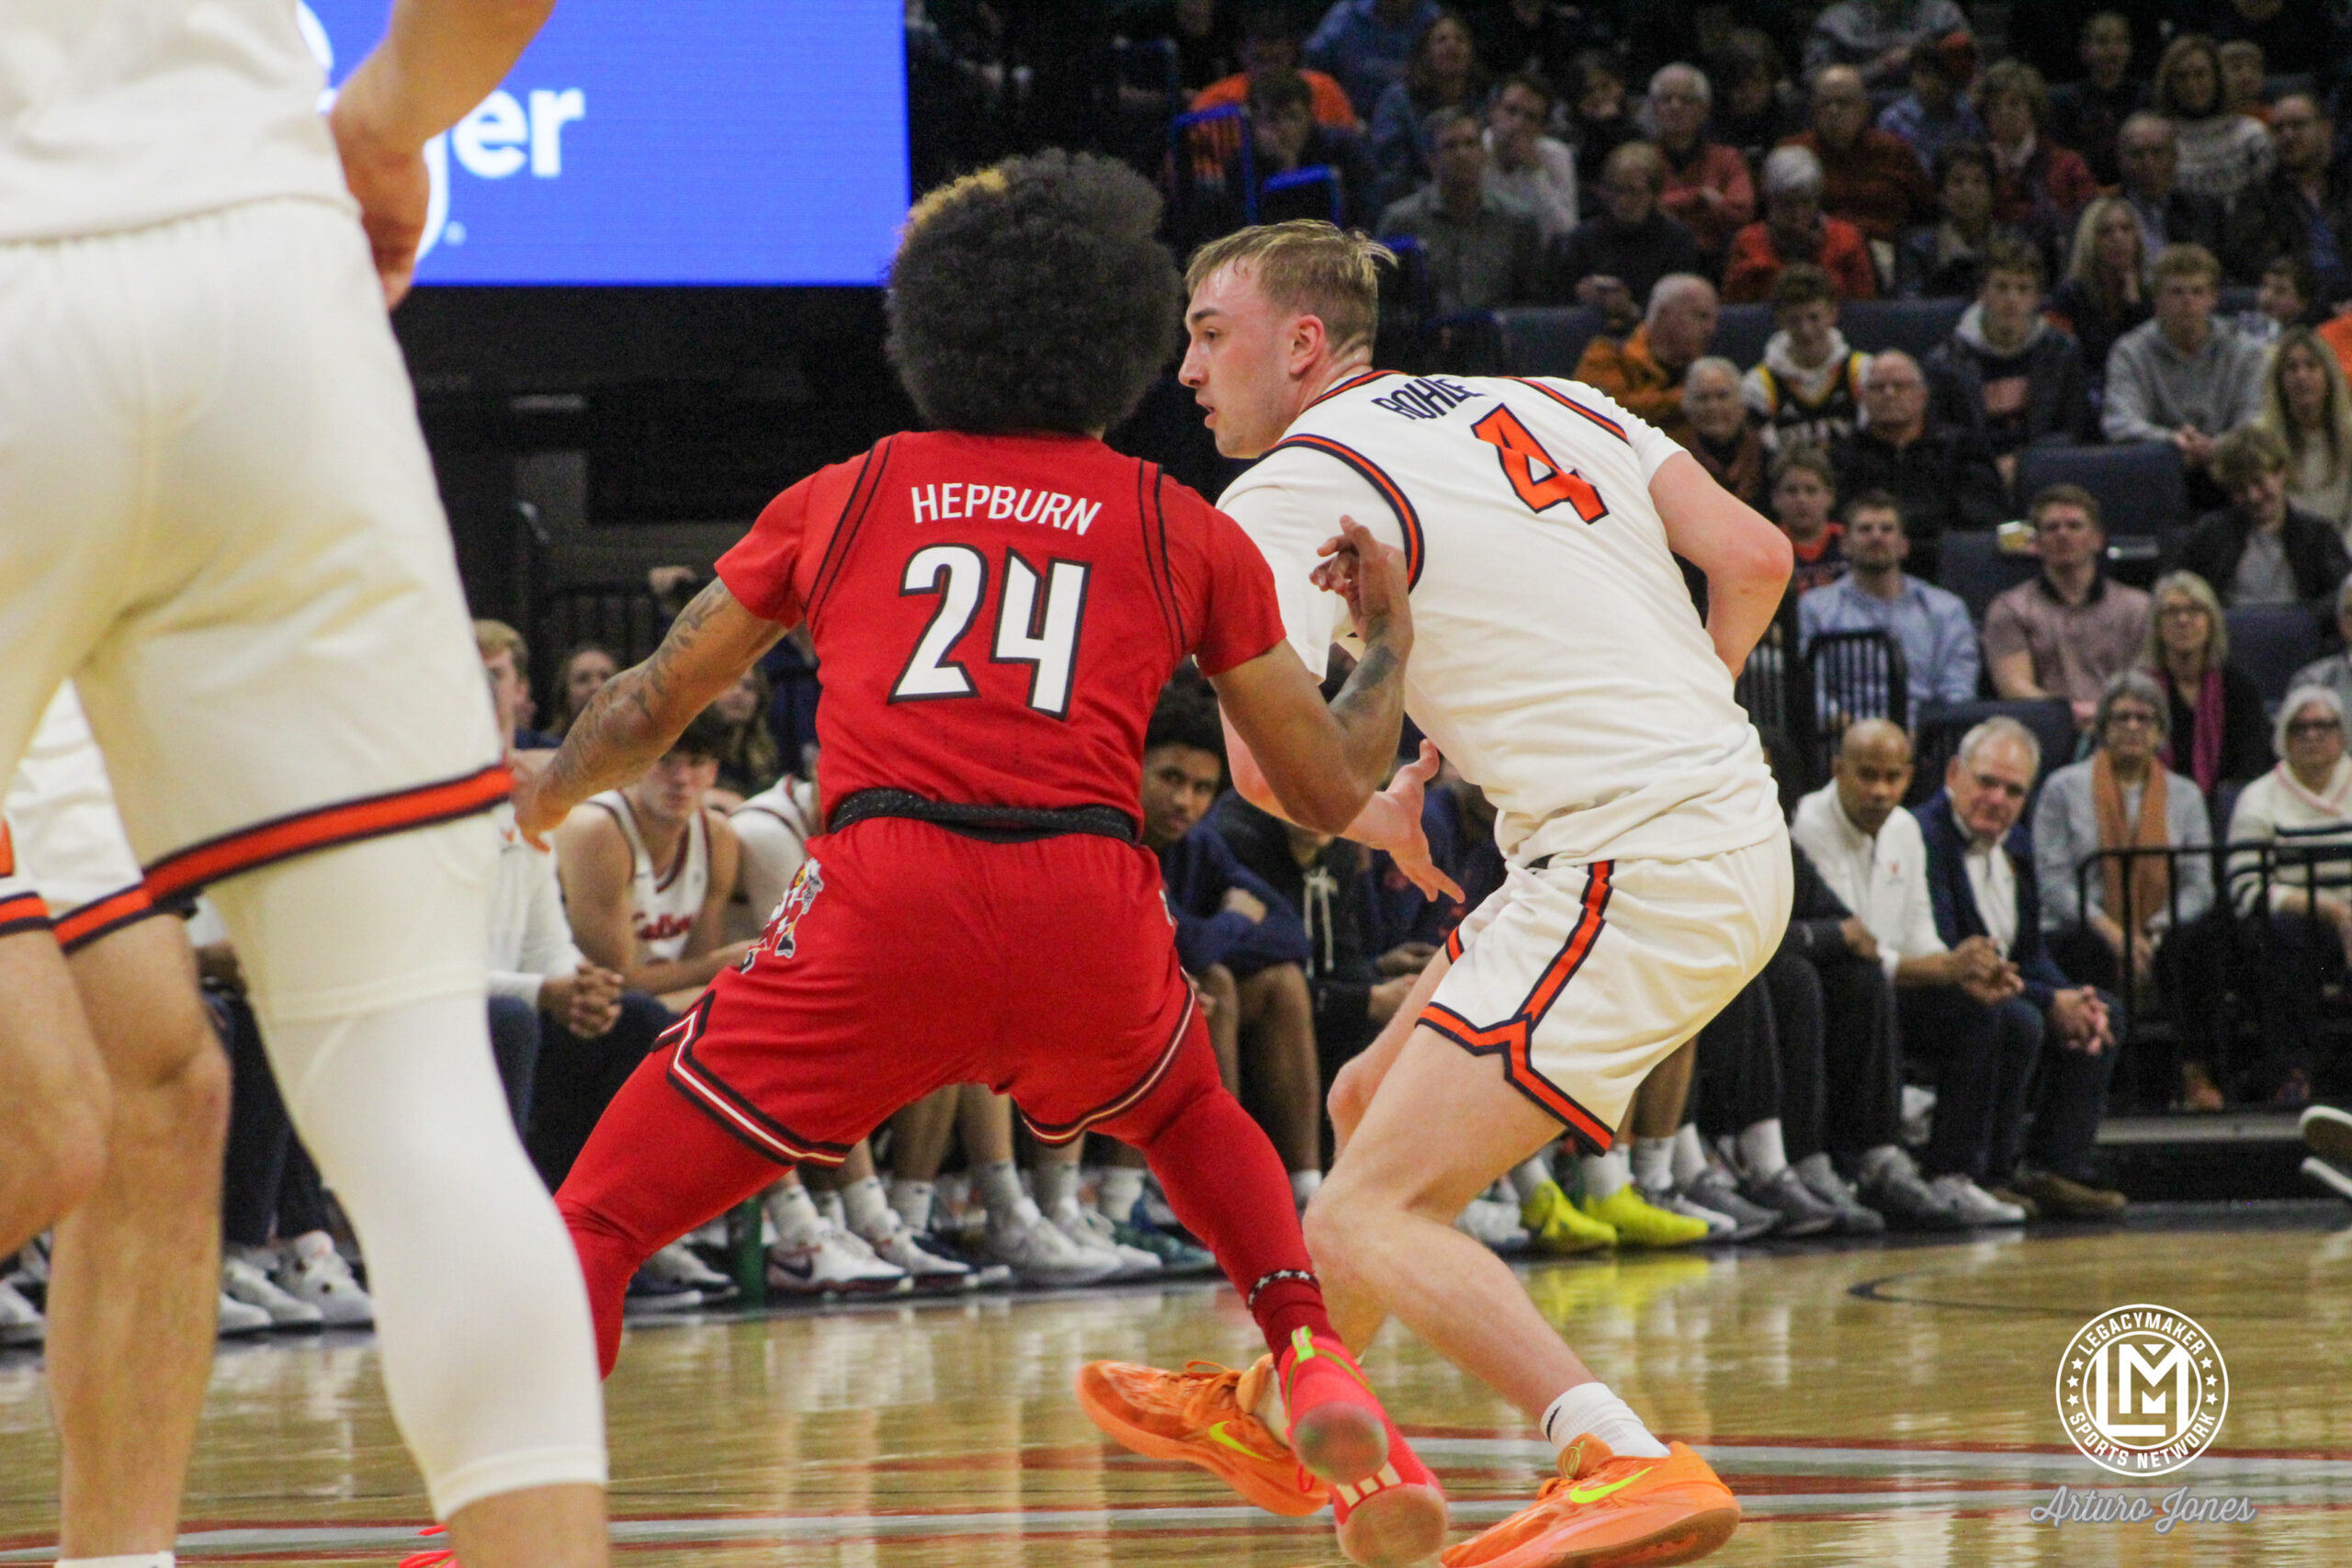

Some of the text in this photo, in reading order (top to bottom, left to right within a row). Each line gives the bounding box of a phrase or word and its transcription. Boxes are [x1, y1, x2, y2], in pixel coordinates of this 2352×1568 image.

[910, 481, 1103, 536] HEPBURN
[1470, 402, 1610, 525] 4
[887, 542, 1092, 722] 24
